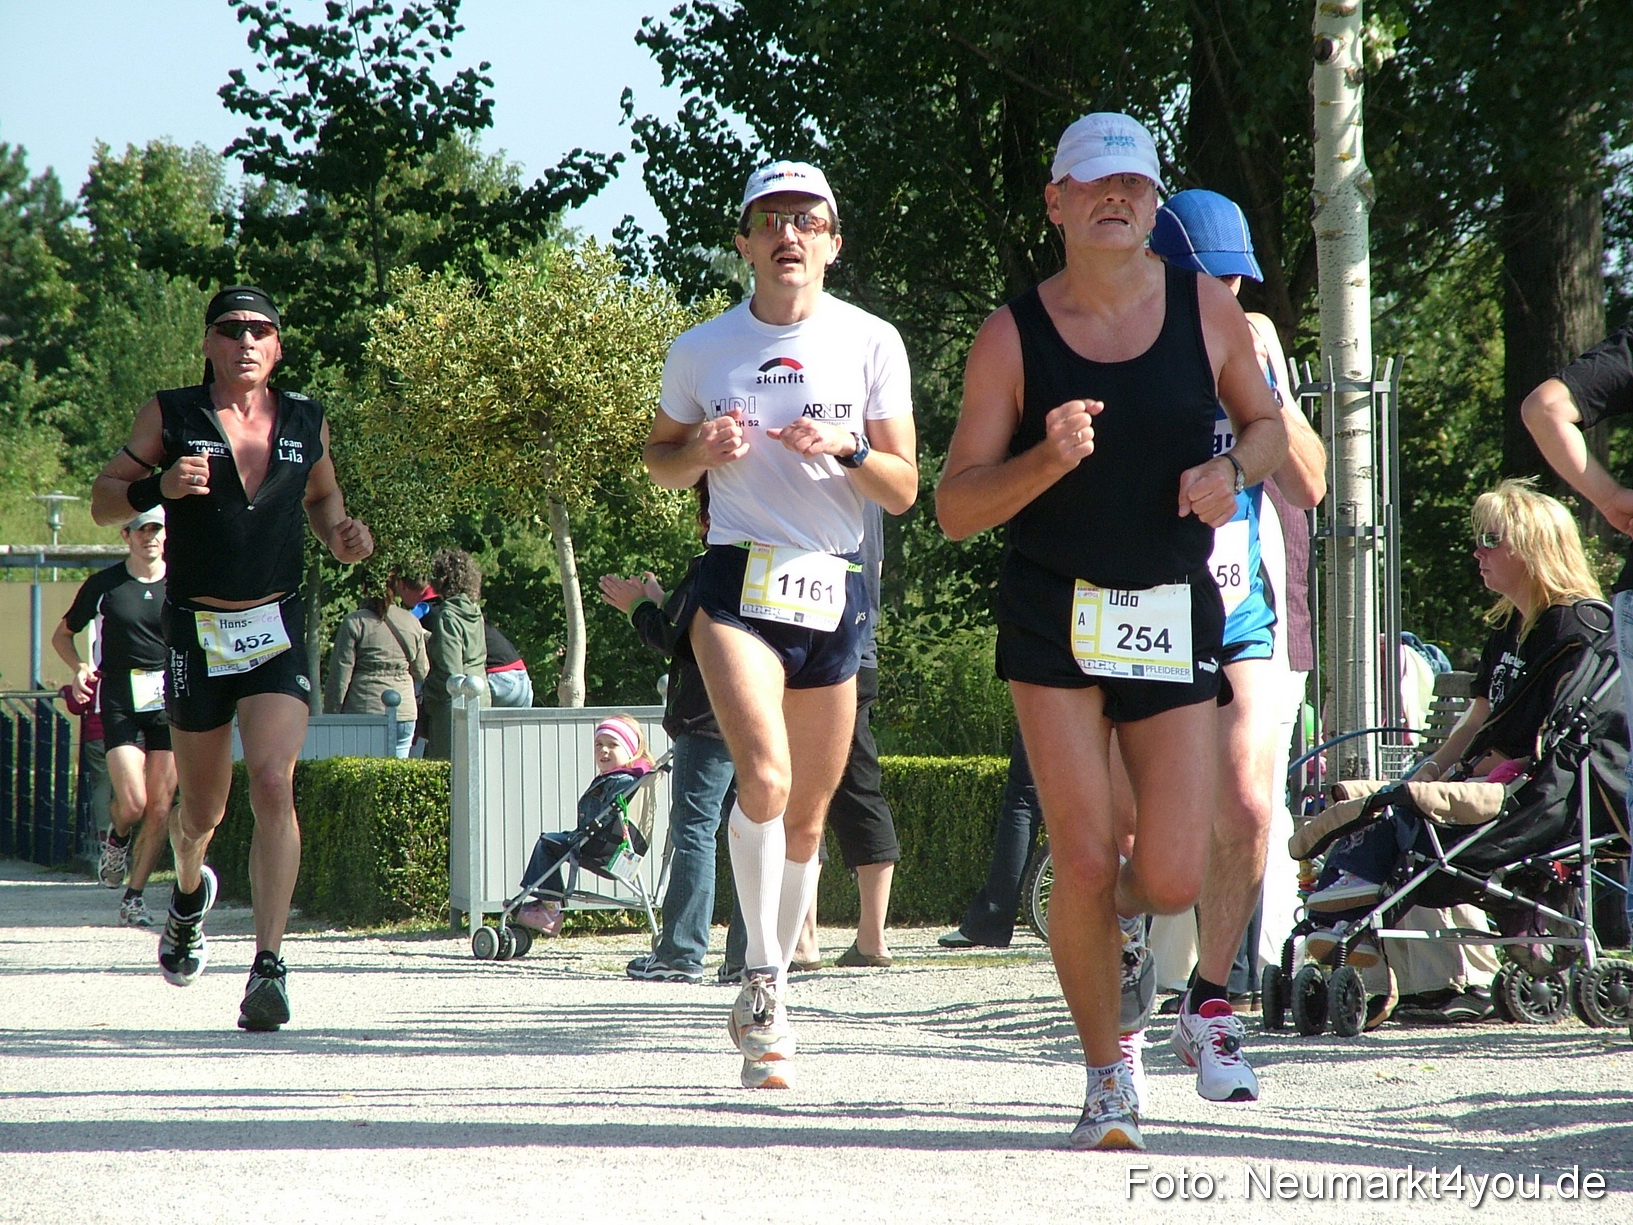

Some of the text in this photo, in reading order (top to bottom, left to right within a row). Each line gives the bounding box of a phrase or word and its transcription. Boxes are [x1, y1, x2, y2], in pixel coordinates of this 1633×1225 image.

[756, 373, 804, 384] skinfit
[801, 403, 852, 418] ARNDT
[748, 419, 760, 427] 52
[279, 437, 303, 449] Team
[196, 446, 225, 455] LANGE
[278, 448, 303, 463] Lila
[778, 573, 833, 605] 1161
[1109, 589, 1139, 607] Udo
[1078, 612, 1085, 626] A
[203, 638, 209, 647] A
[234, 633, 274, 653] 452
[1117, 623, 1172, 653] 254
[176, 654, 185, 690] LANGE
[1145, 664, 1190, 677] PFLEIDERER
